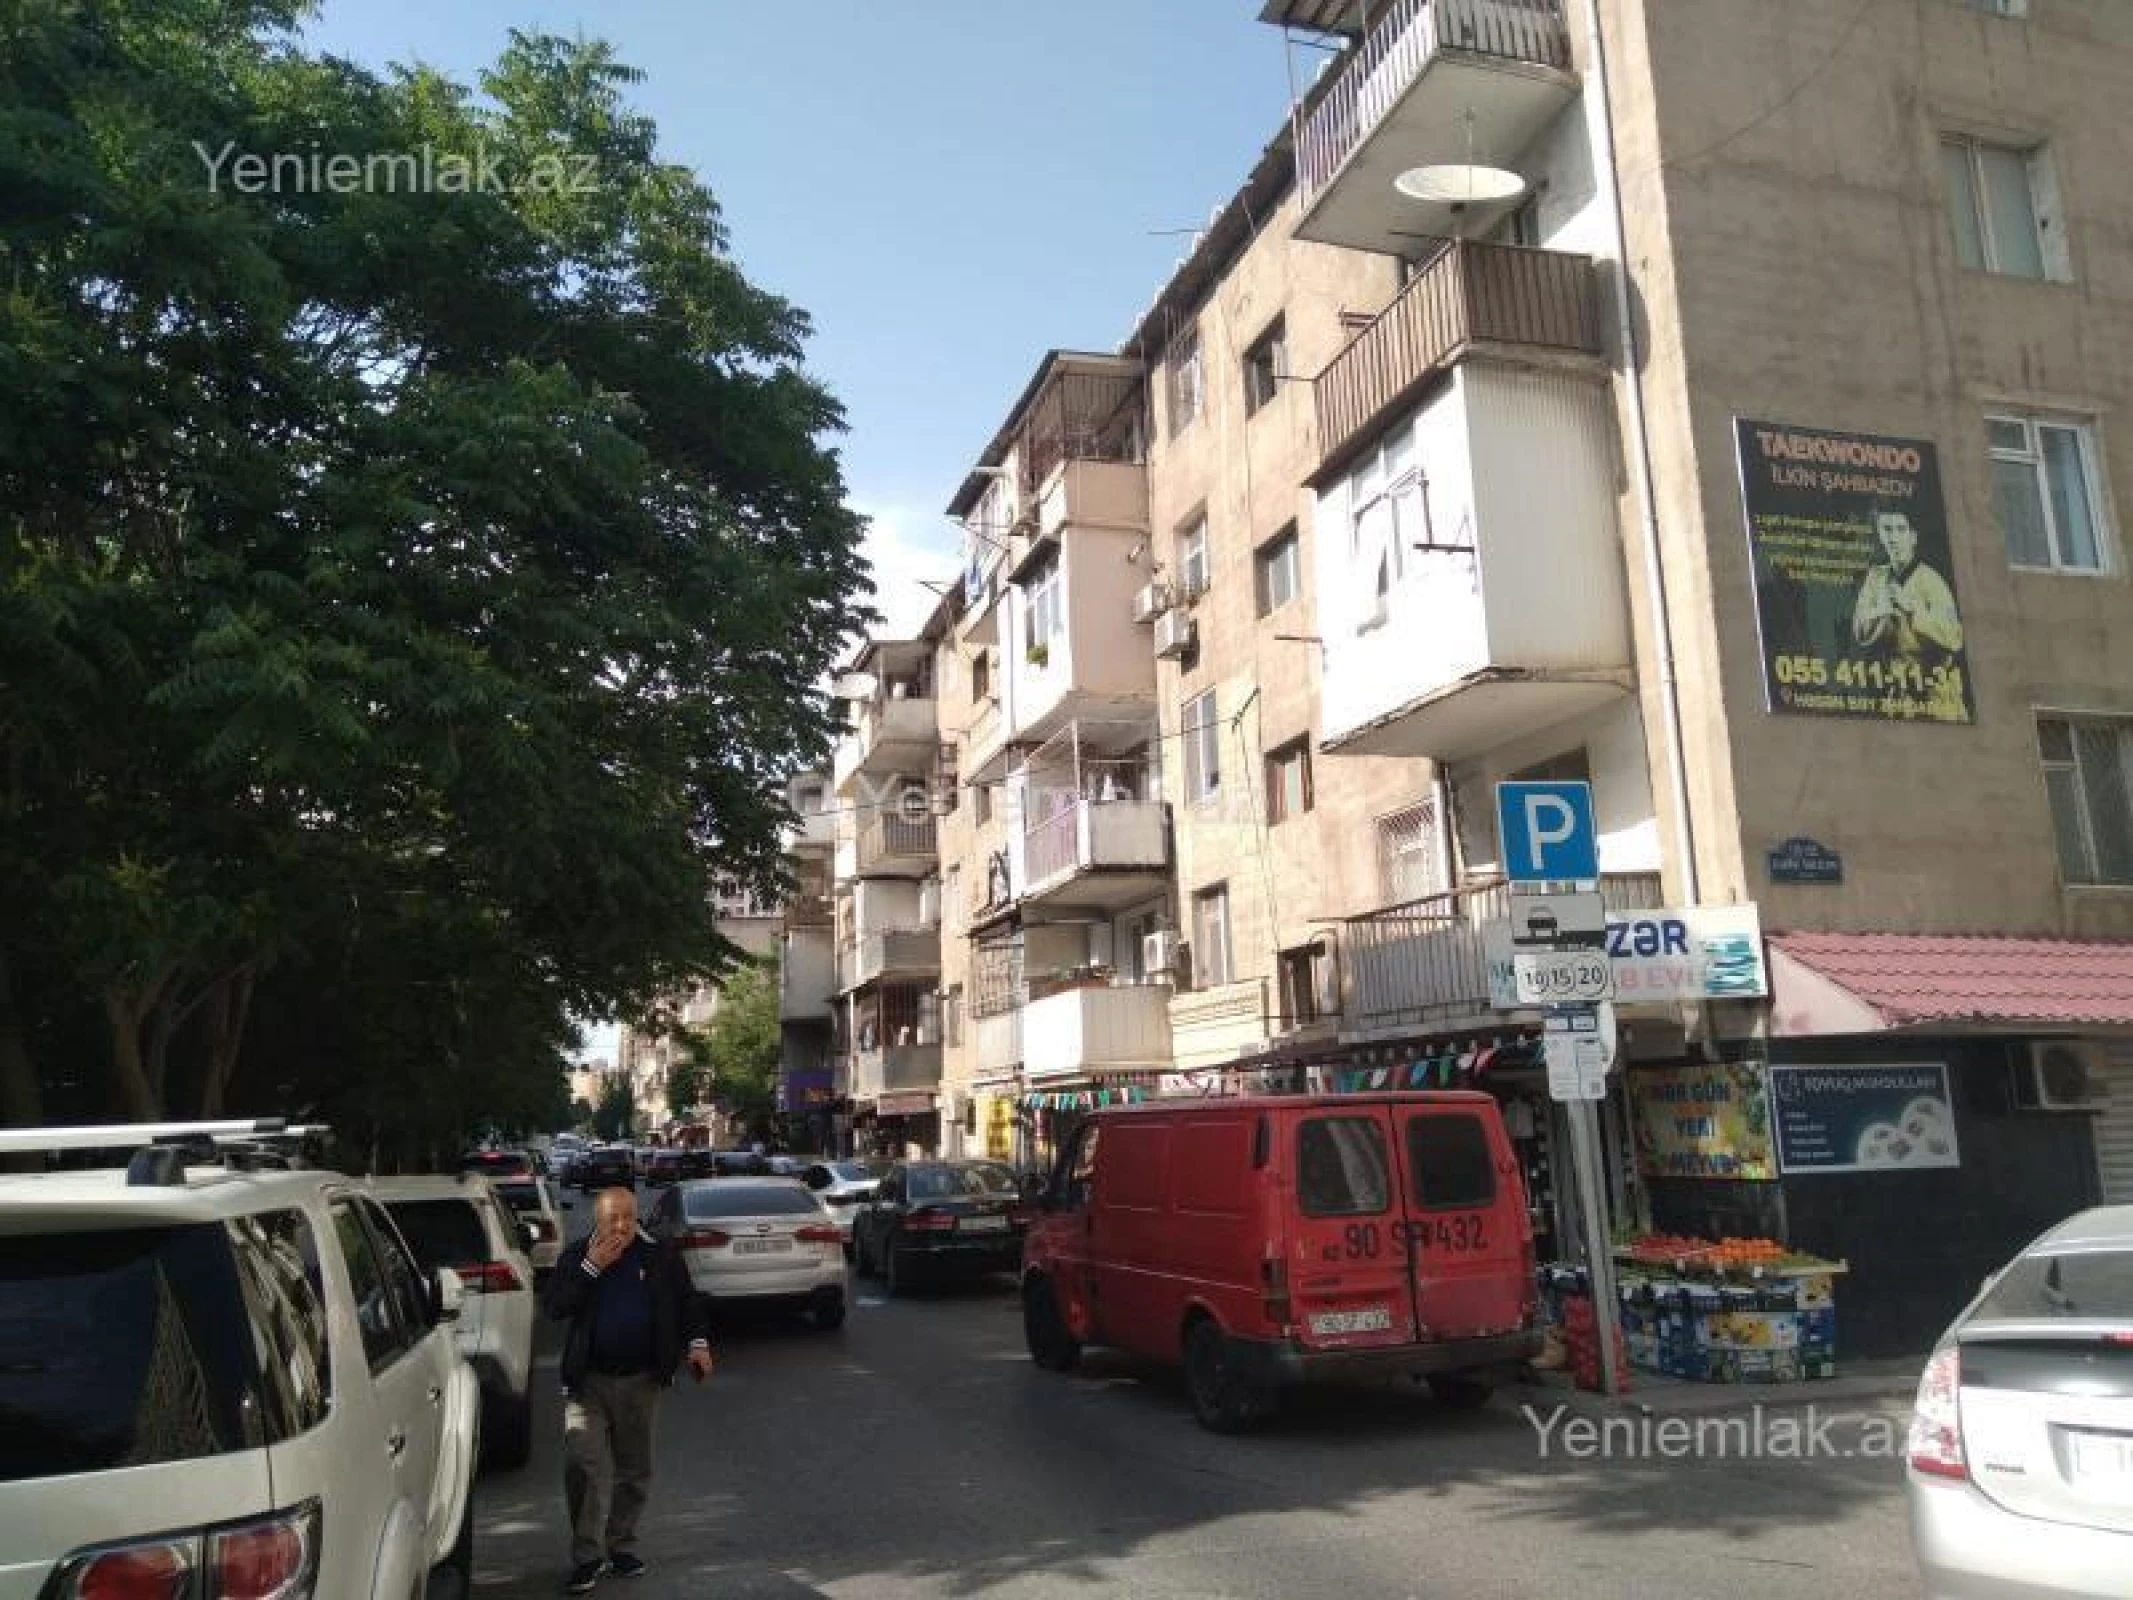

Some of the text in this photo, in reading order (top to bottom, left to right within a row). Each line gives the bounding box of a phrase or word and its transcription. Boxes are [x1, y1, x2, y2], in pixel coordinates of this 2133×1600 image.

[1757, 431, 1921, 473] TAEKWONDO
[1774, 655, 1828, 686] 055
[1525, 795, 1576, 869] P
[1552, 967, 1571, 985] 15
[1577, 963, 1602, 984] 20
[1436, 1214, 1490, 1253] 432
